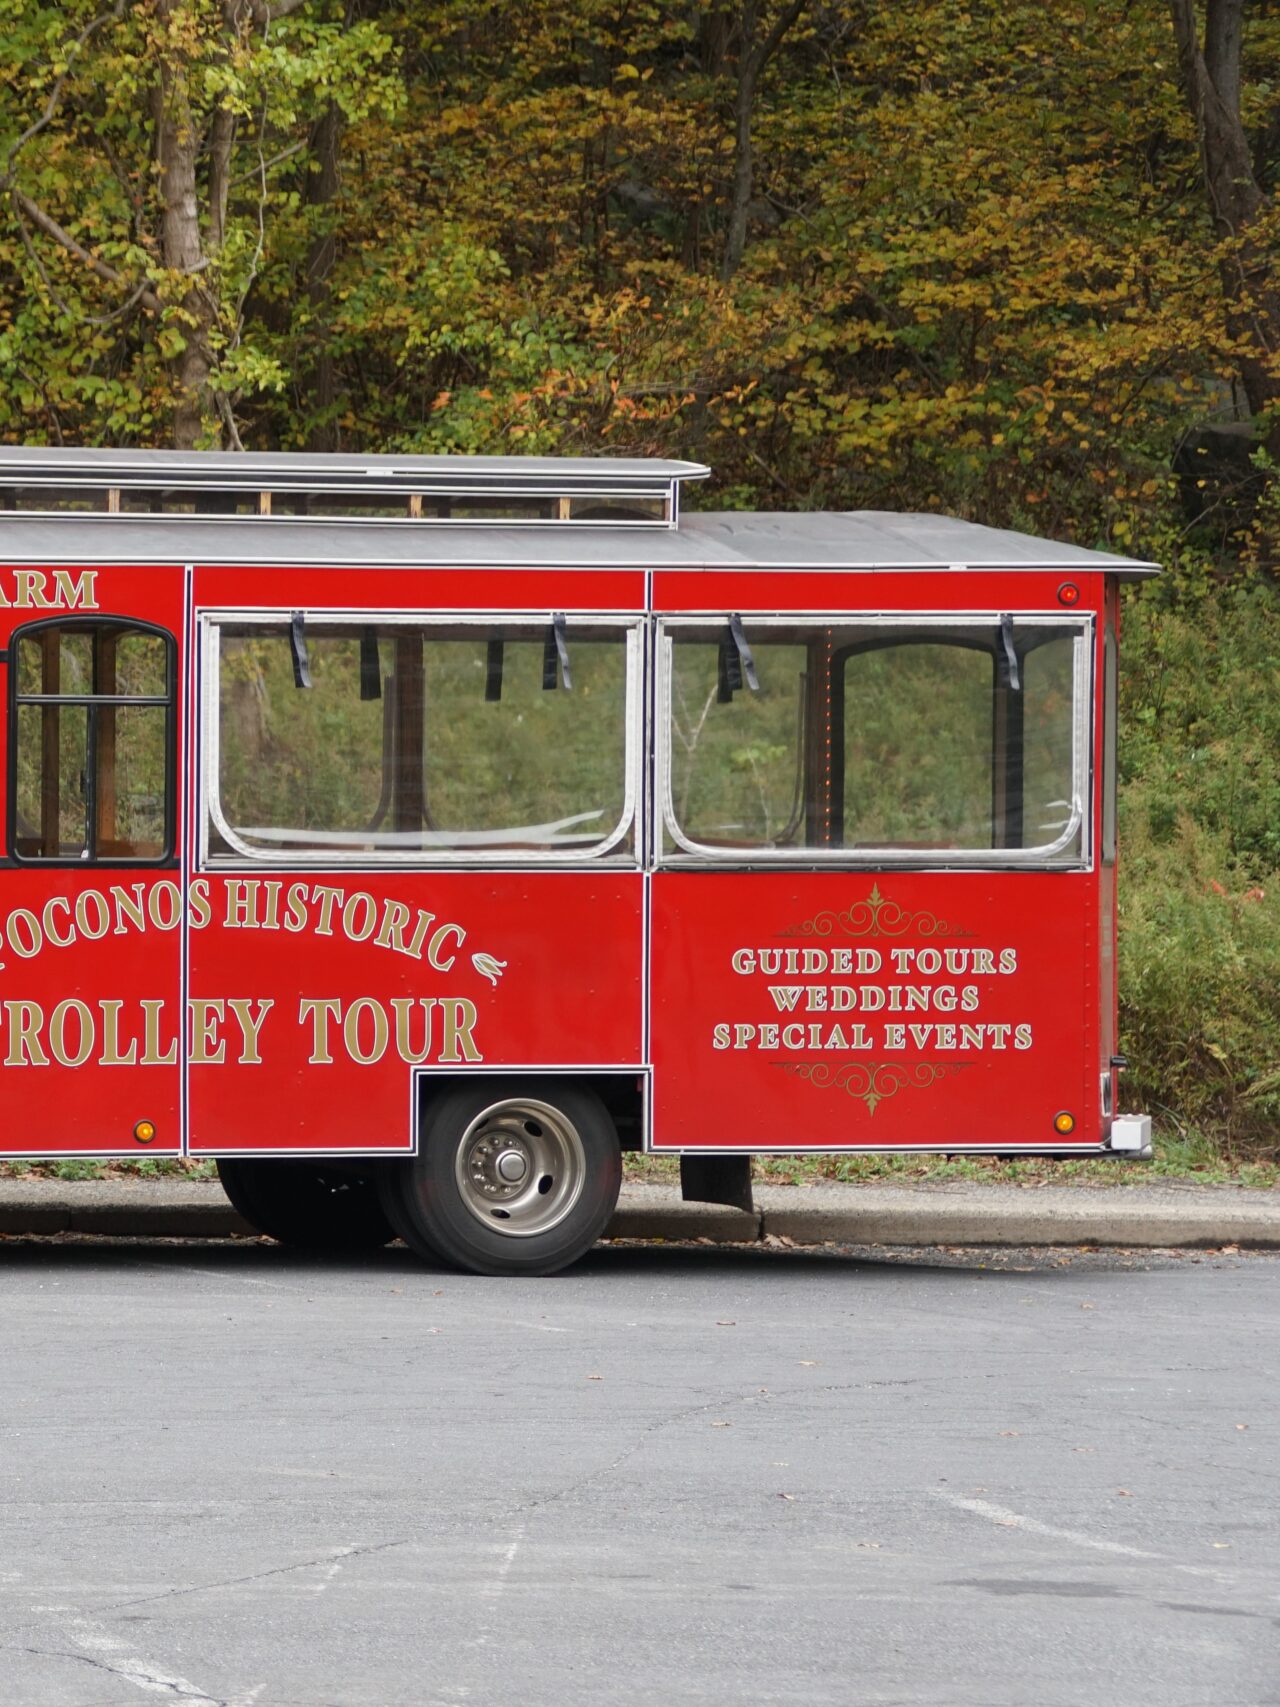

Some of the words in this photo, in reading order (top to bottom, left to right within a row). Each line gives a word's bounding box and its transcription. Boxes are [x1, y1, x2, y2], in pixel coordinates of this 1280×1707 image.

[223, 879, 466, 972] HISTORIC
[731, 948, 882, 975] GUIDED
[890, 948, 1018, 975] TOURS
[768, 985, 980, 1012] WEDDINGS
[299, 997, 483, 1067] TOUR
[712, 1023, 873, 1050] SPECIAL
[884, 1023, 1033, 1050] EVENTS
